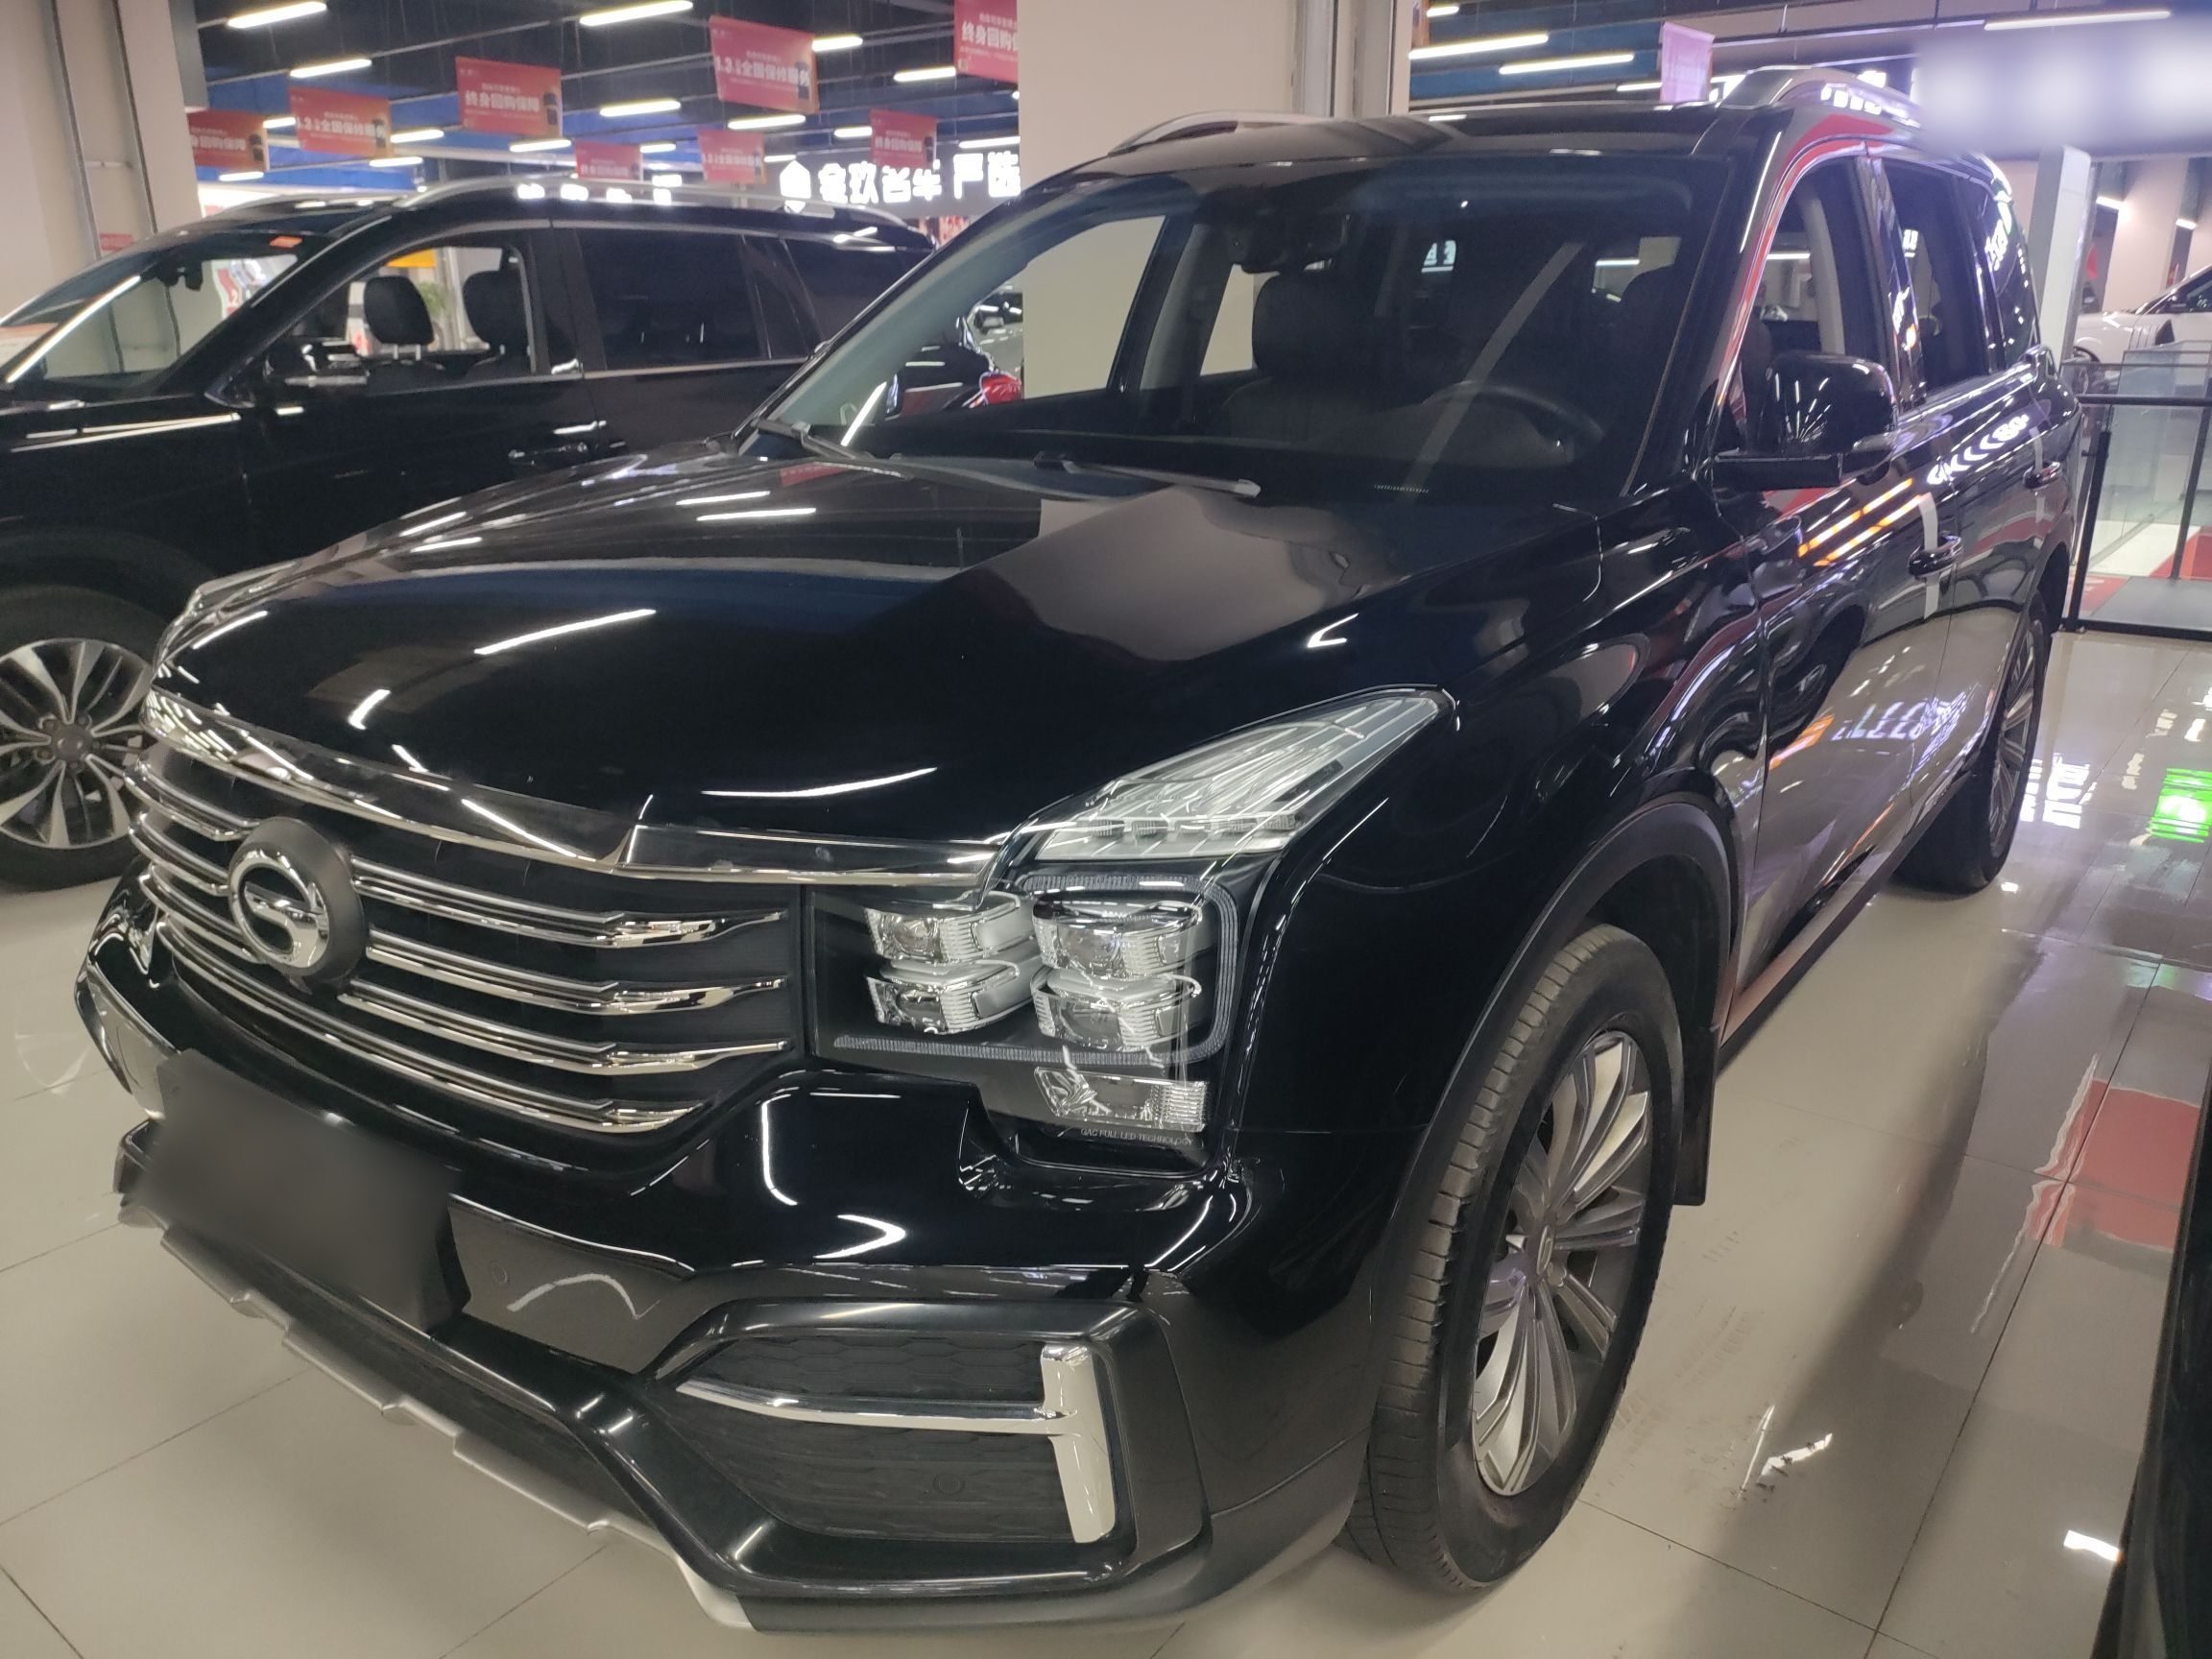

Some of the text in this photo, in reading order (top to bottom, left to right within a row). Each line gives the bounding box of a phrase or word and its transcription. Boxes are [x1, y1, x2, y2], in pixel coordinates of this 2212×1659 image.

[1080, 1128, 1193, 1145] GAC FULL LED TECHNOLOGY
